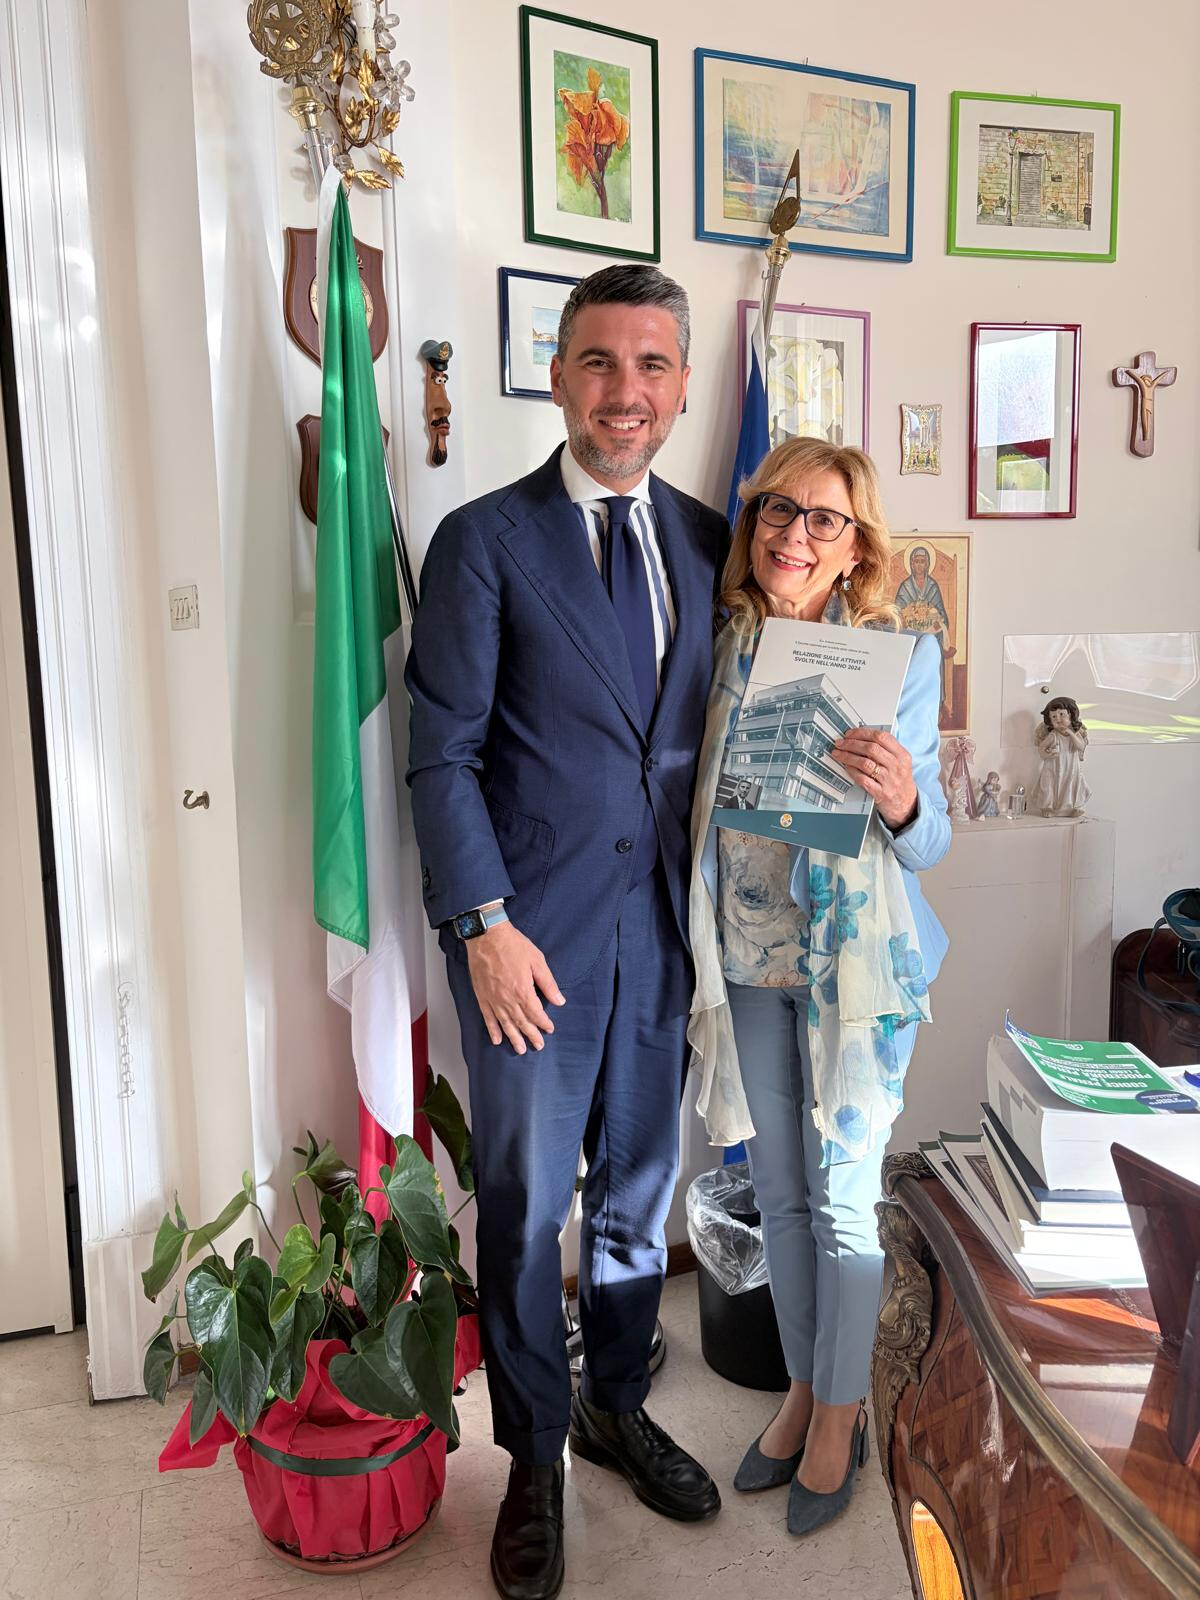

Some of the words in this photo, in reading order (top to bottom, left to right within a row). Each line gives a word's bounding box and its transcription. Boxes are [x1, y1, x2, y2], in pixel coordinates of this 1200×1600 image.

[793, 650, 822, 658] RELAZIONE
[840, 657, 866, 665] ATTIVITÀ
[815, 660, 847, 668] NELL'ANNO
[1058, 1074, 1101, 1086] PENALE
[1080, 1071, 1153, 1079] PROCEDURA
